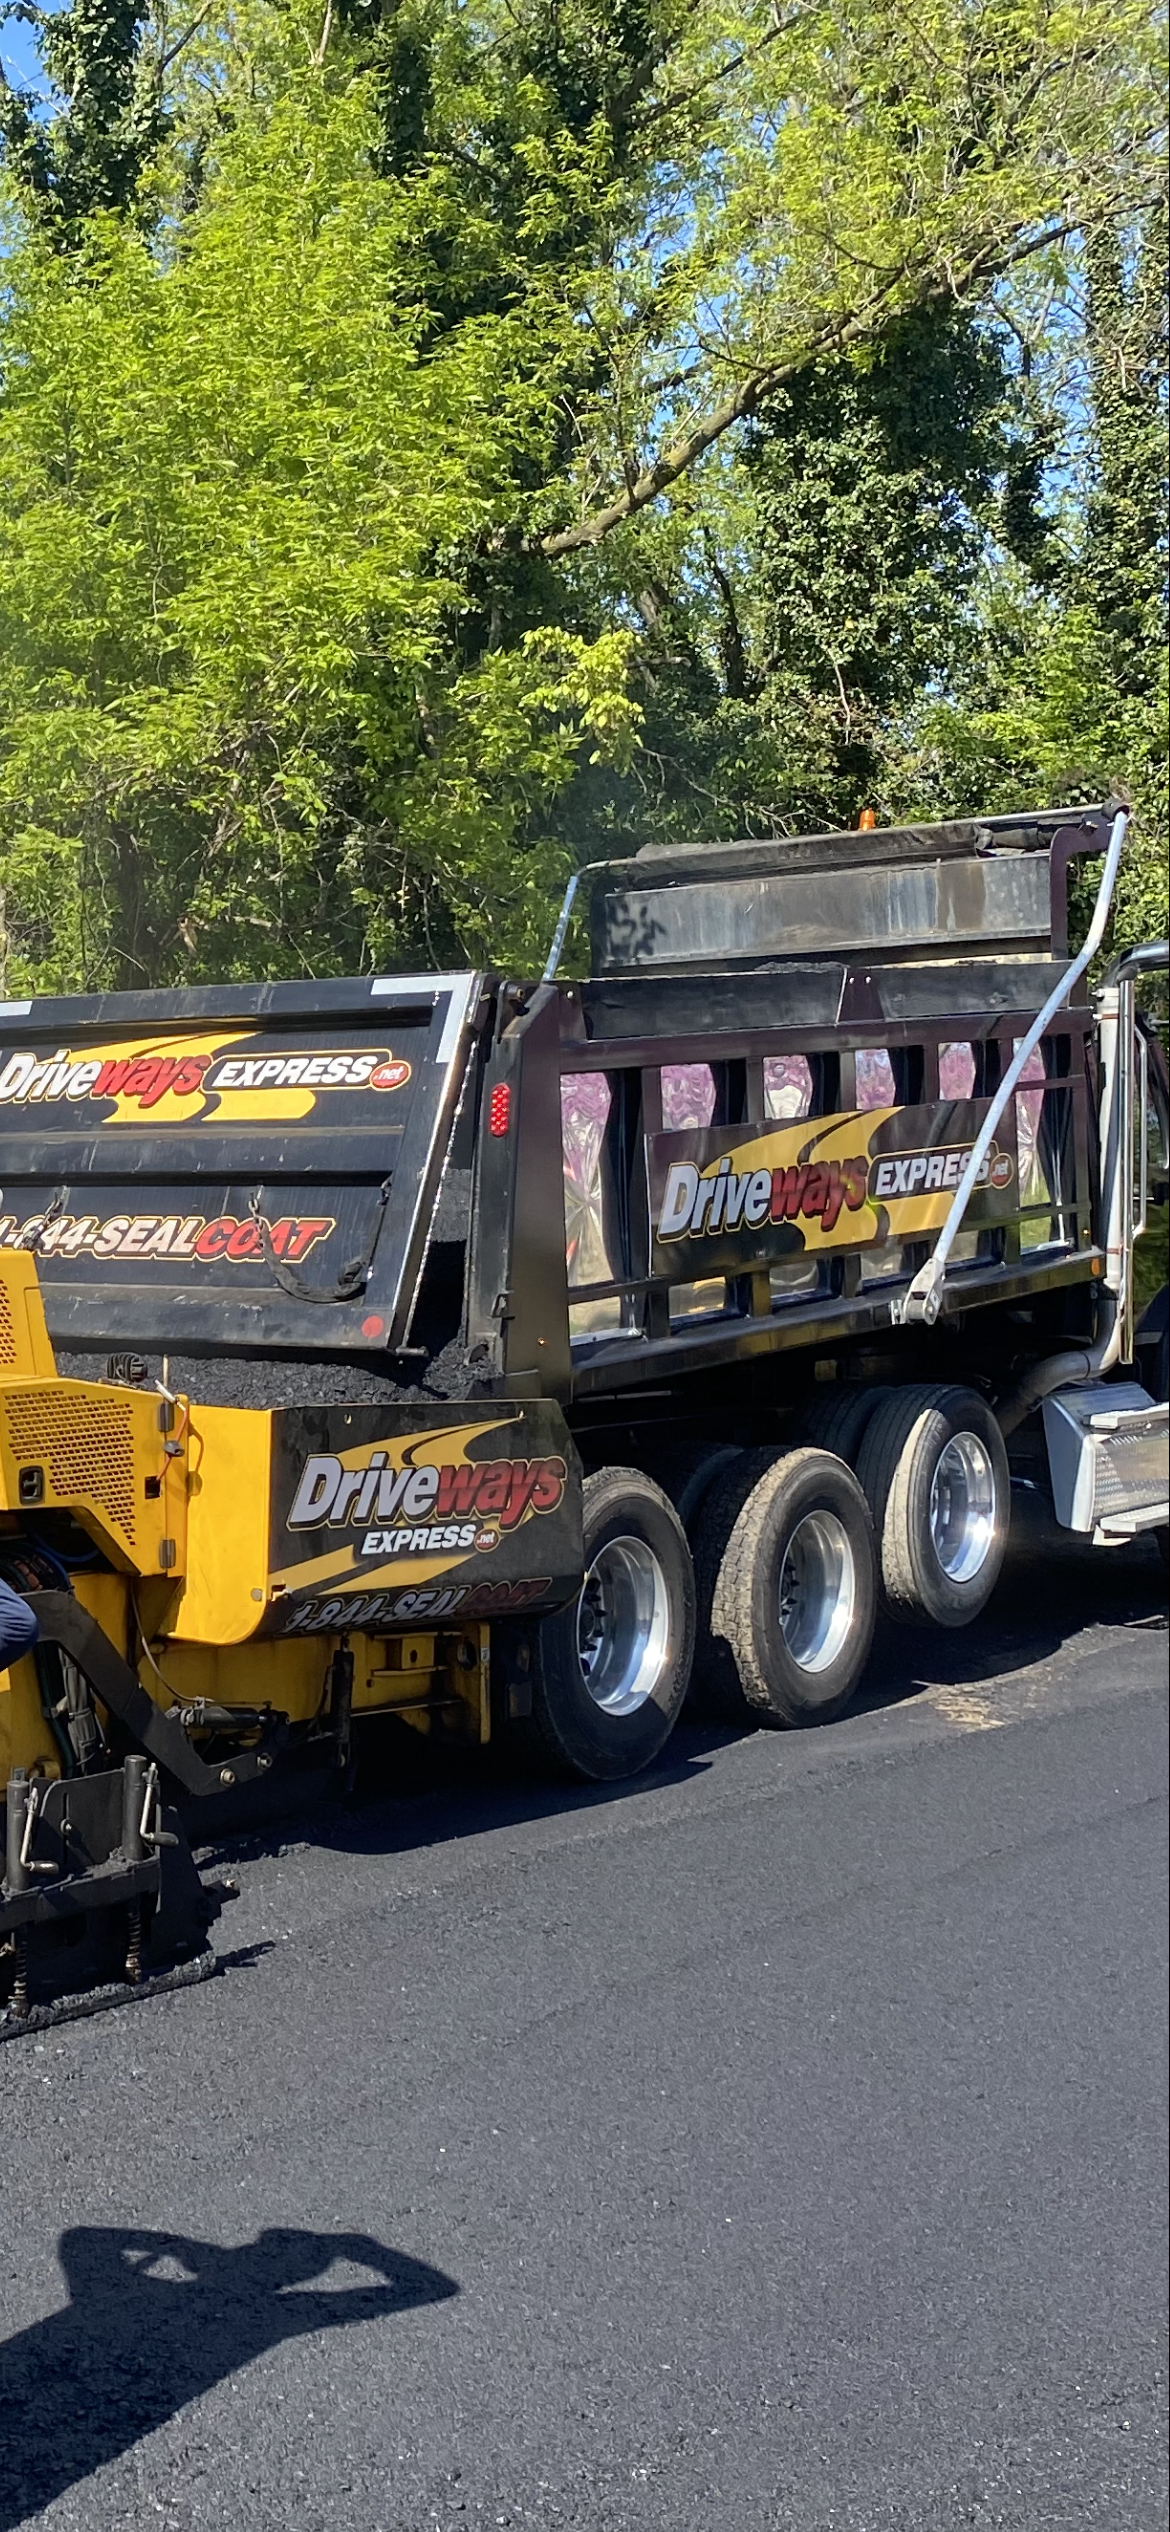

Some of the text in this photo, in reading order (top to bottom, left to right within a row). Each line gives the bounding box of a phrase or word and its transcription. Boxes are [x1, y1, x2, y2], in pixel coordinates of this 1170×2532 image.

[0, 1050, 211, 1108] Driveways
[212, 1055, 378, 1087] EXPRESS
[658, 1156, 867, 1241] Driveways
[287, 1453, 566, 1532] Driveways
[361, 1524, 476, 1555] EXPRESS
